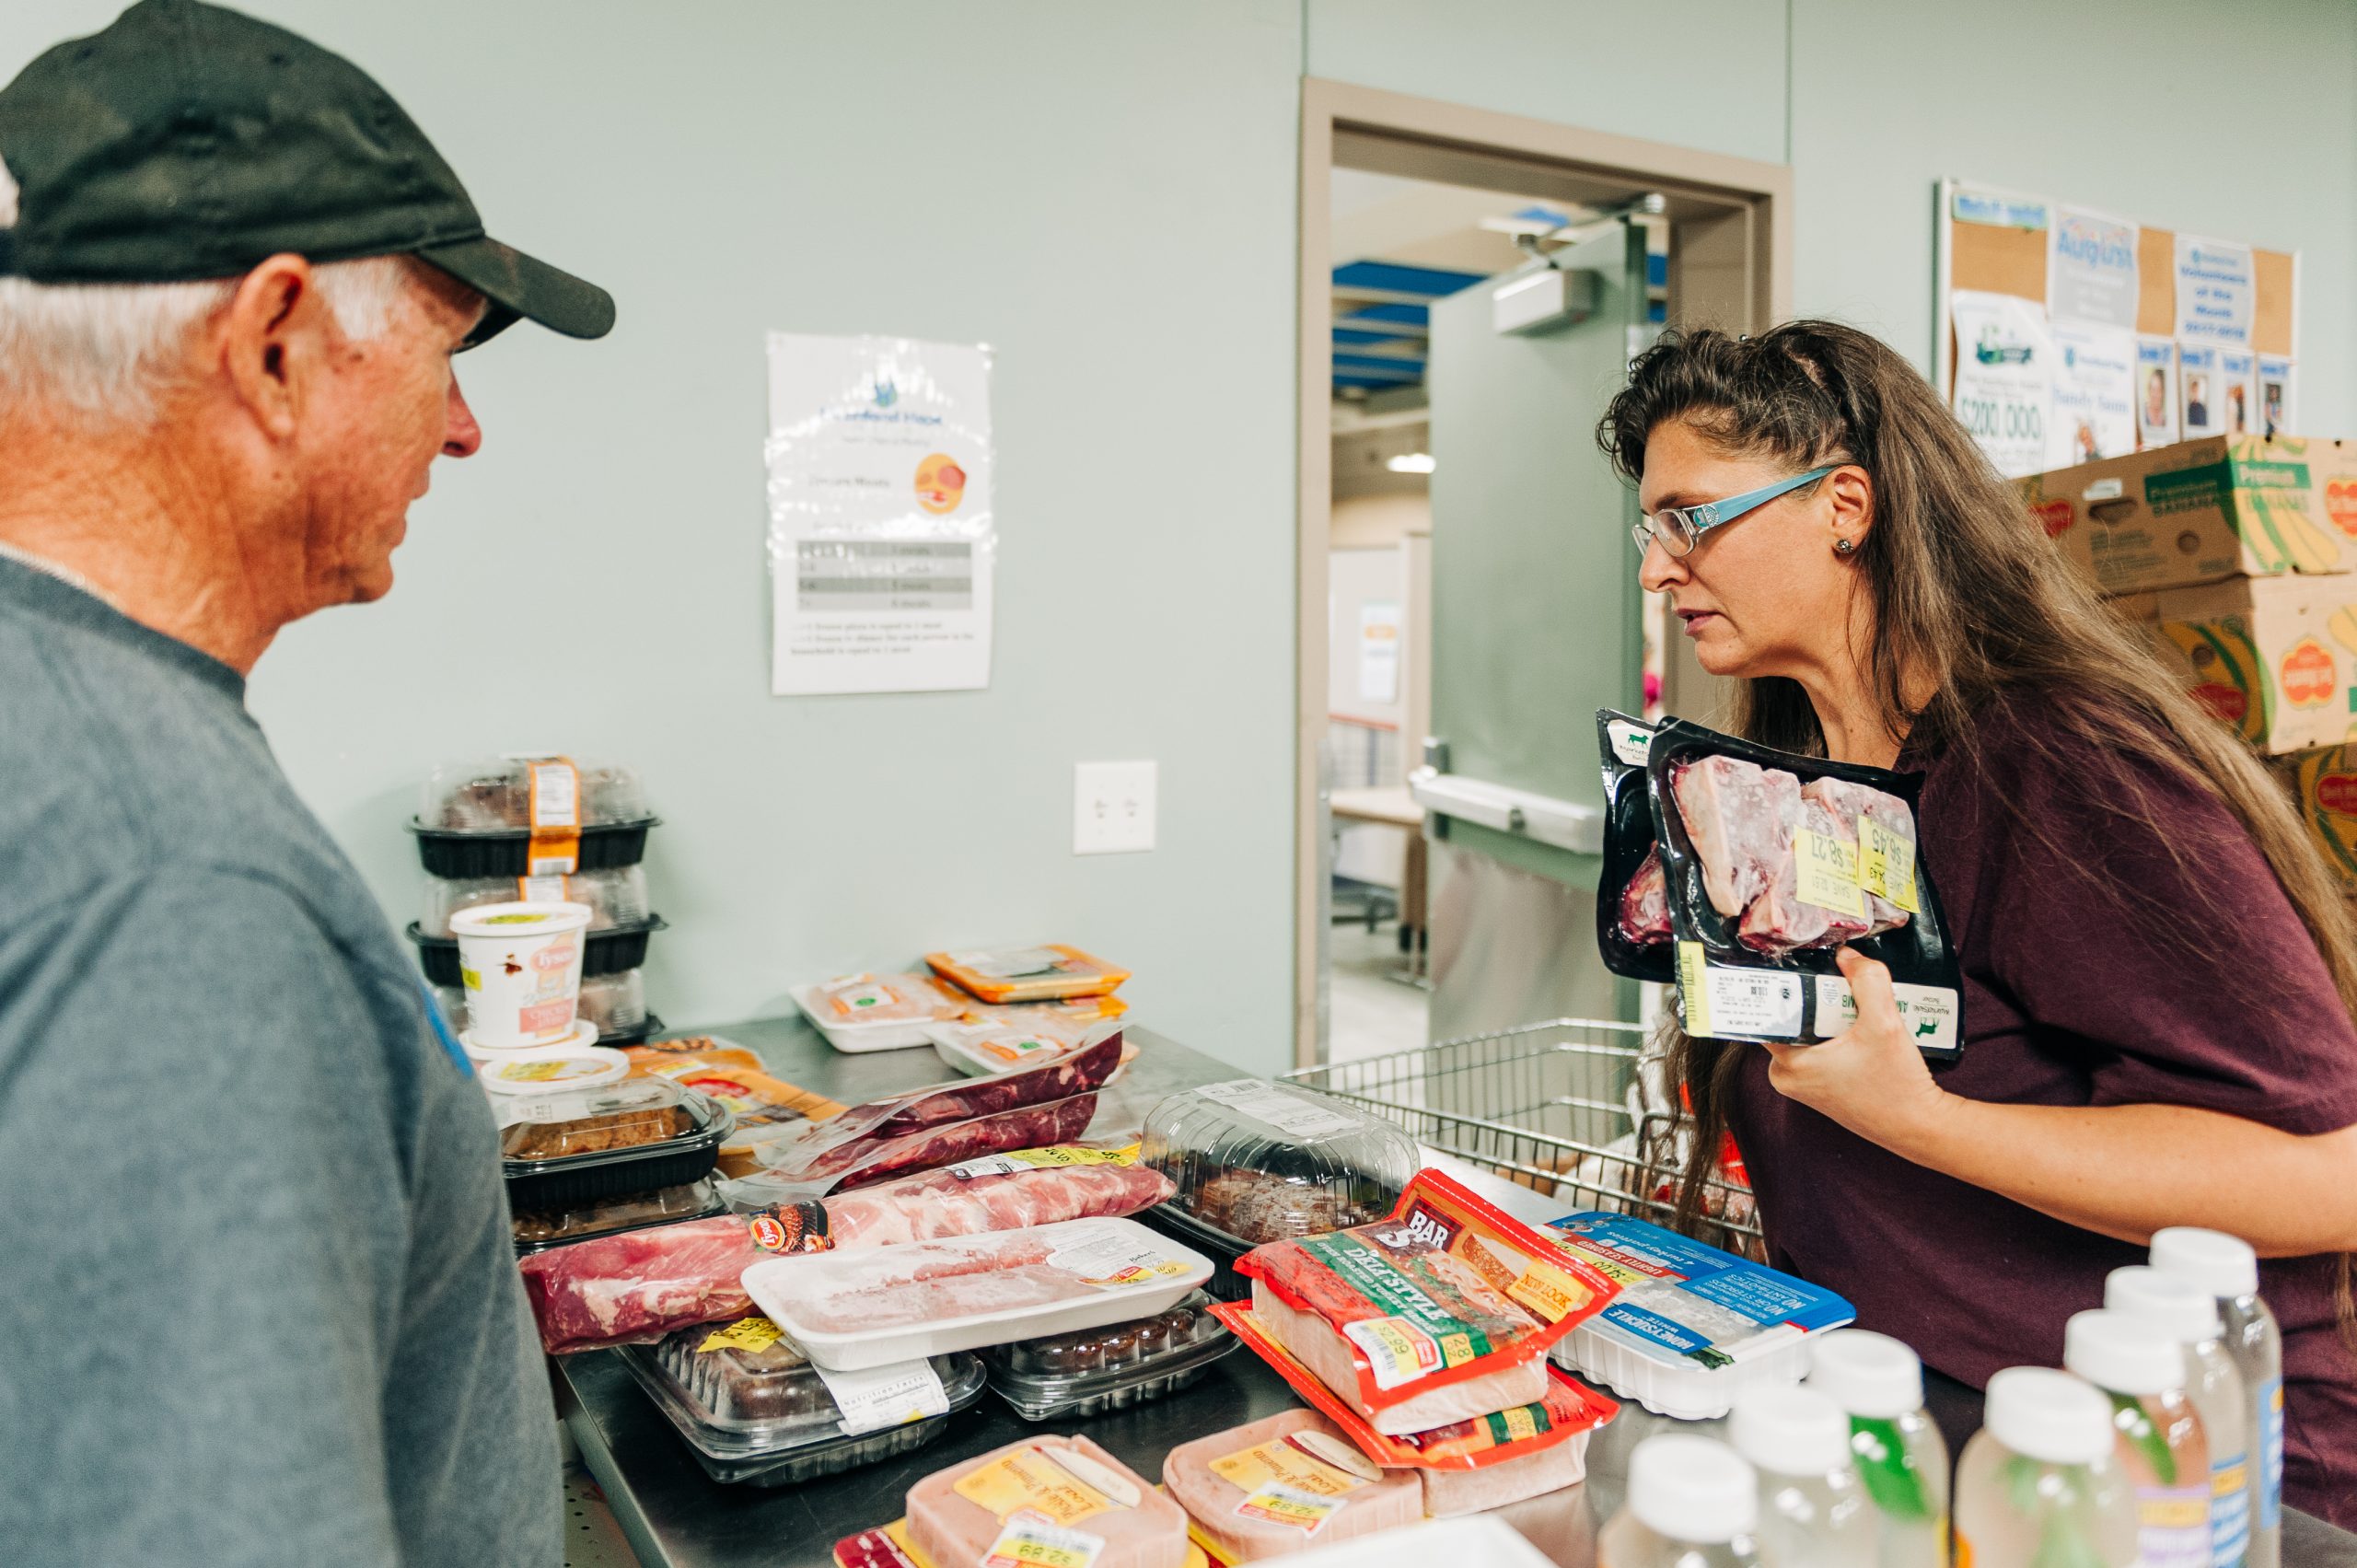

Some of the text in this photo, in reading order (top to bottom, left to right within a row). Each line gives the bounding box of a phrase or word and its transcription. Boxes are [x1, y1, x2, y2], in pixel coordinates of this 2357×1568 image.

[2058, 229, 2134, 270] August
[1811, 834, 1843, 867] $8.27
[760, 1220, 779, 1245] Tyson
[1376, 1227, 1416, 1248] S
[1409, 1210, 1449, 1249] BAR
[1576, 1240, 1626, 1261] SEASONED
[1620, 1256, 1663, 1275] LIGHTLY
[1541, 1284, 1573, 1308] LOOK
[1781, 1297, 1806, 1309] NO
[1763, 1304, 1789, 1316] NO
[1608, 1309, 1695, 1350] HONEYSUCKLE
[1646, 1316, 1680, 1333] WHITE
[1378, 1326, 1409, 1354] $2.99
[1252, 1450, 1285, 1478] Pimento
[1306, 1473, 1339, 1496] Loaf
[1057, 1485, 1096, 1512] Loaf
[1018, 1544, 1073, 1565] $2.89
